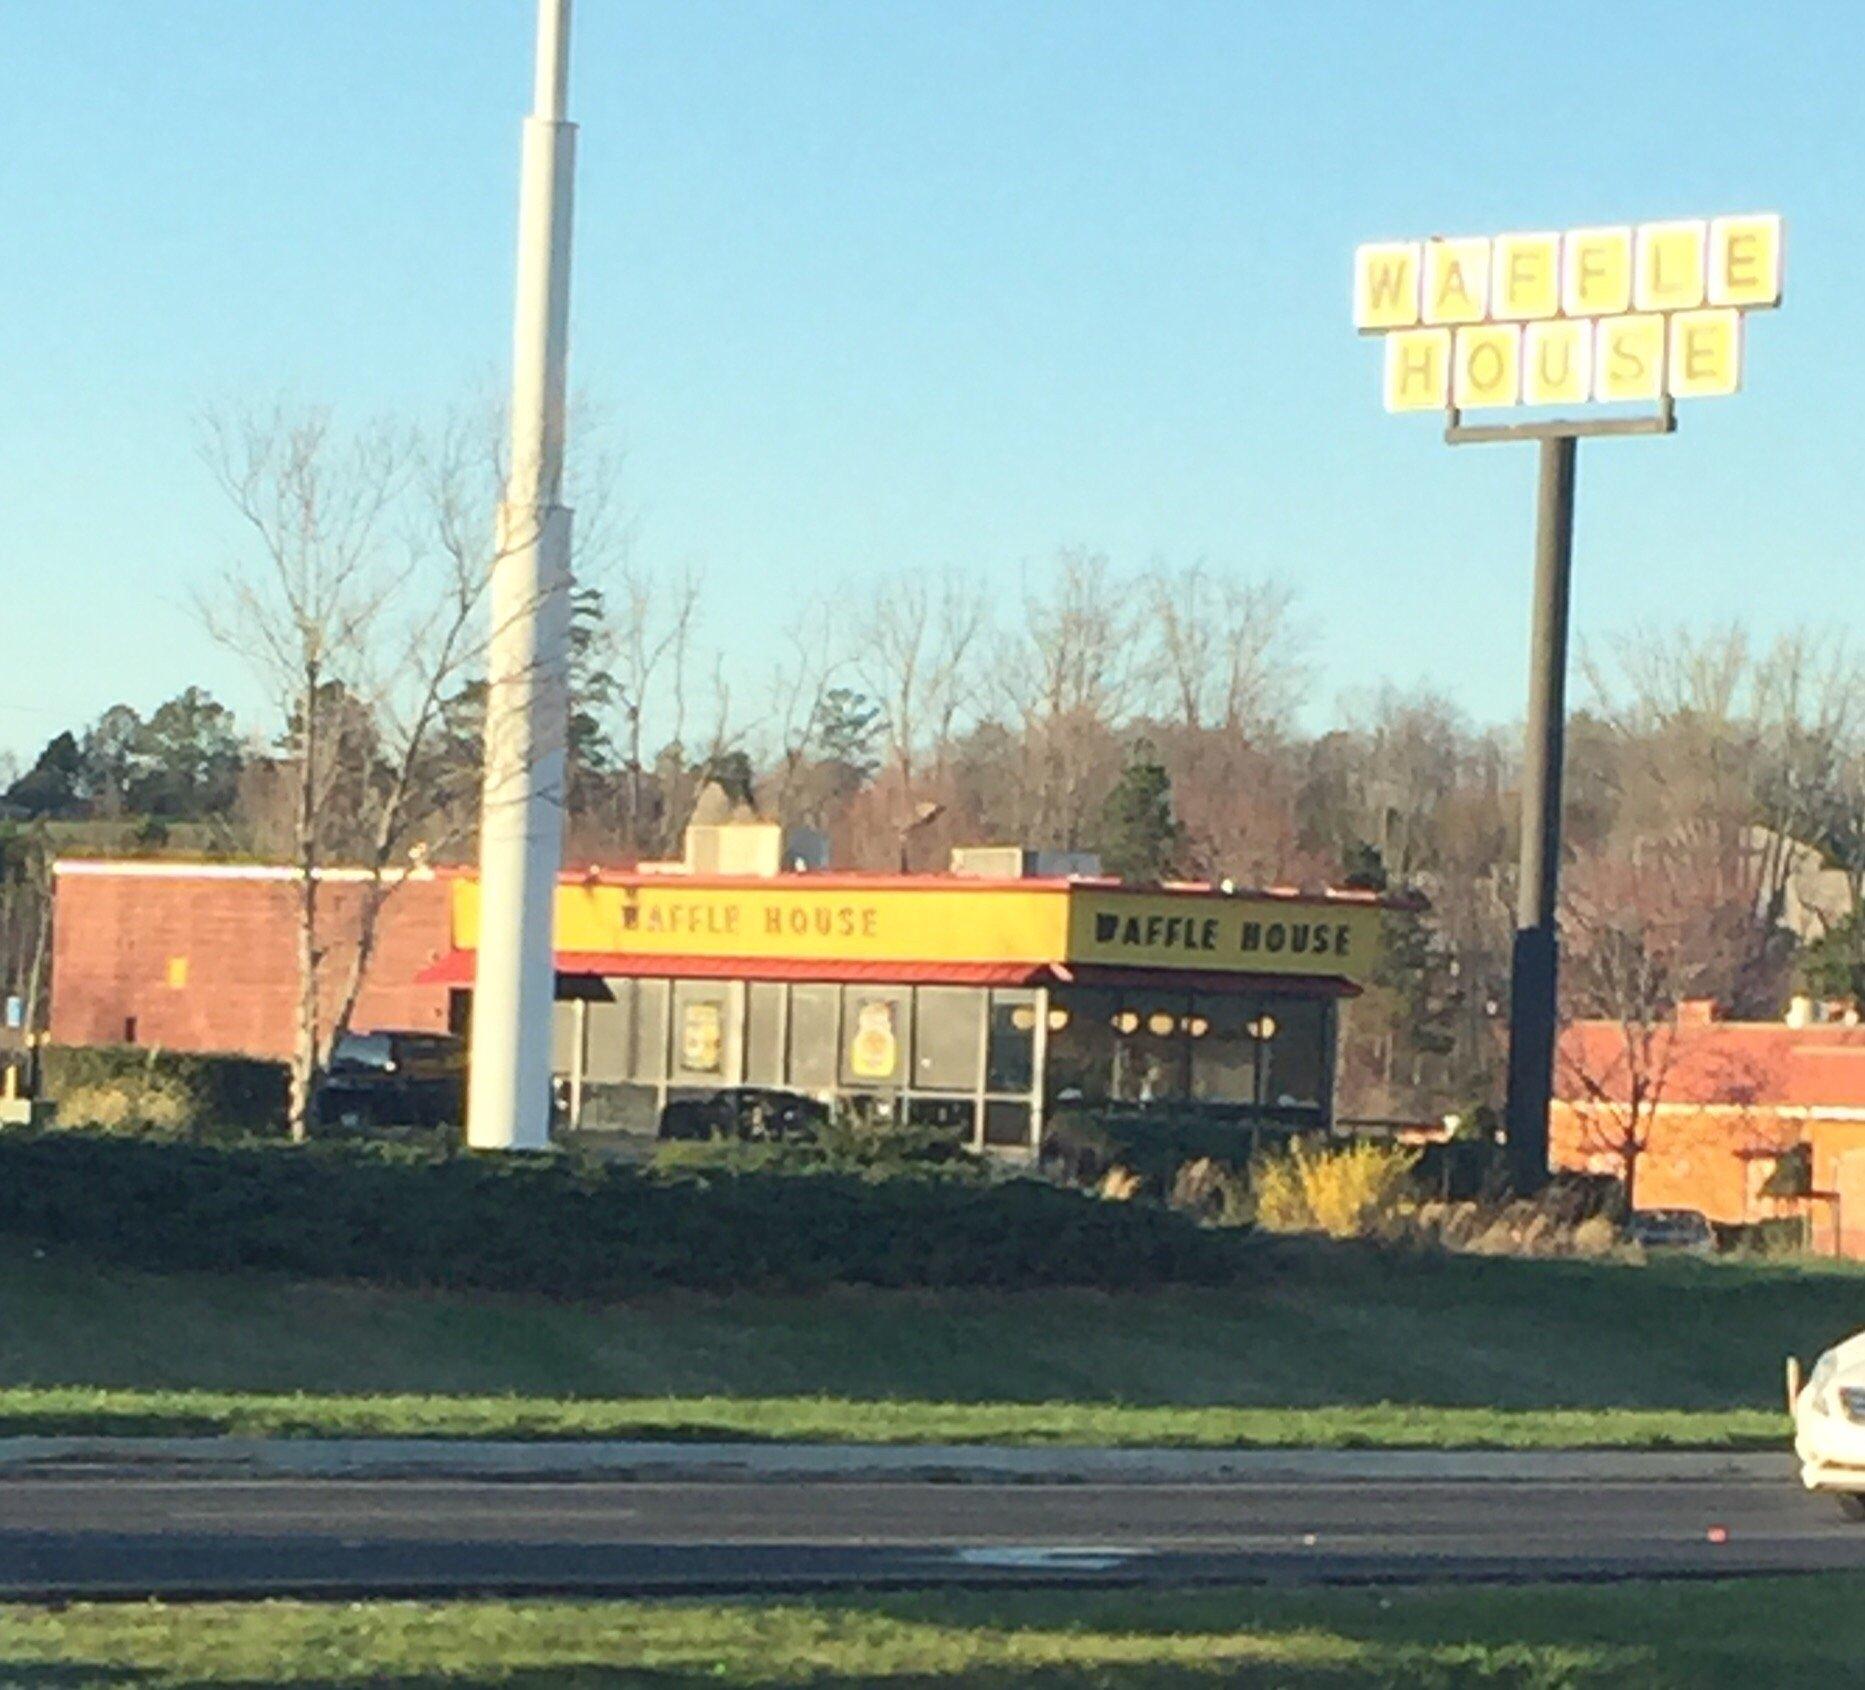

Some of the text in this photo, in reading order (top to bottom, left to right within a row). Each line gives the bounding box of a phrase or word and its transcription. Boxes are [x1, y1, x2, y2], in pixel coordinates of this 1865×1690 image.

[1367, 233, 1758, 310] WAFFLE
[1399, 325, 1719, 395] HOUSE
[622, 904, 878, 936] WAFFLE HOUSE
[1095, 911, 1352, 956] WAFFLE HOUSE
